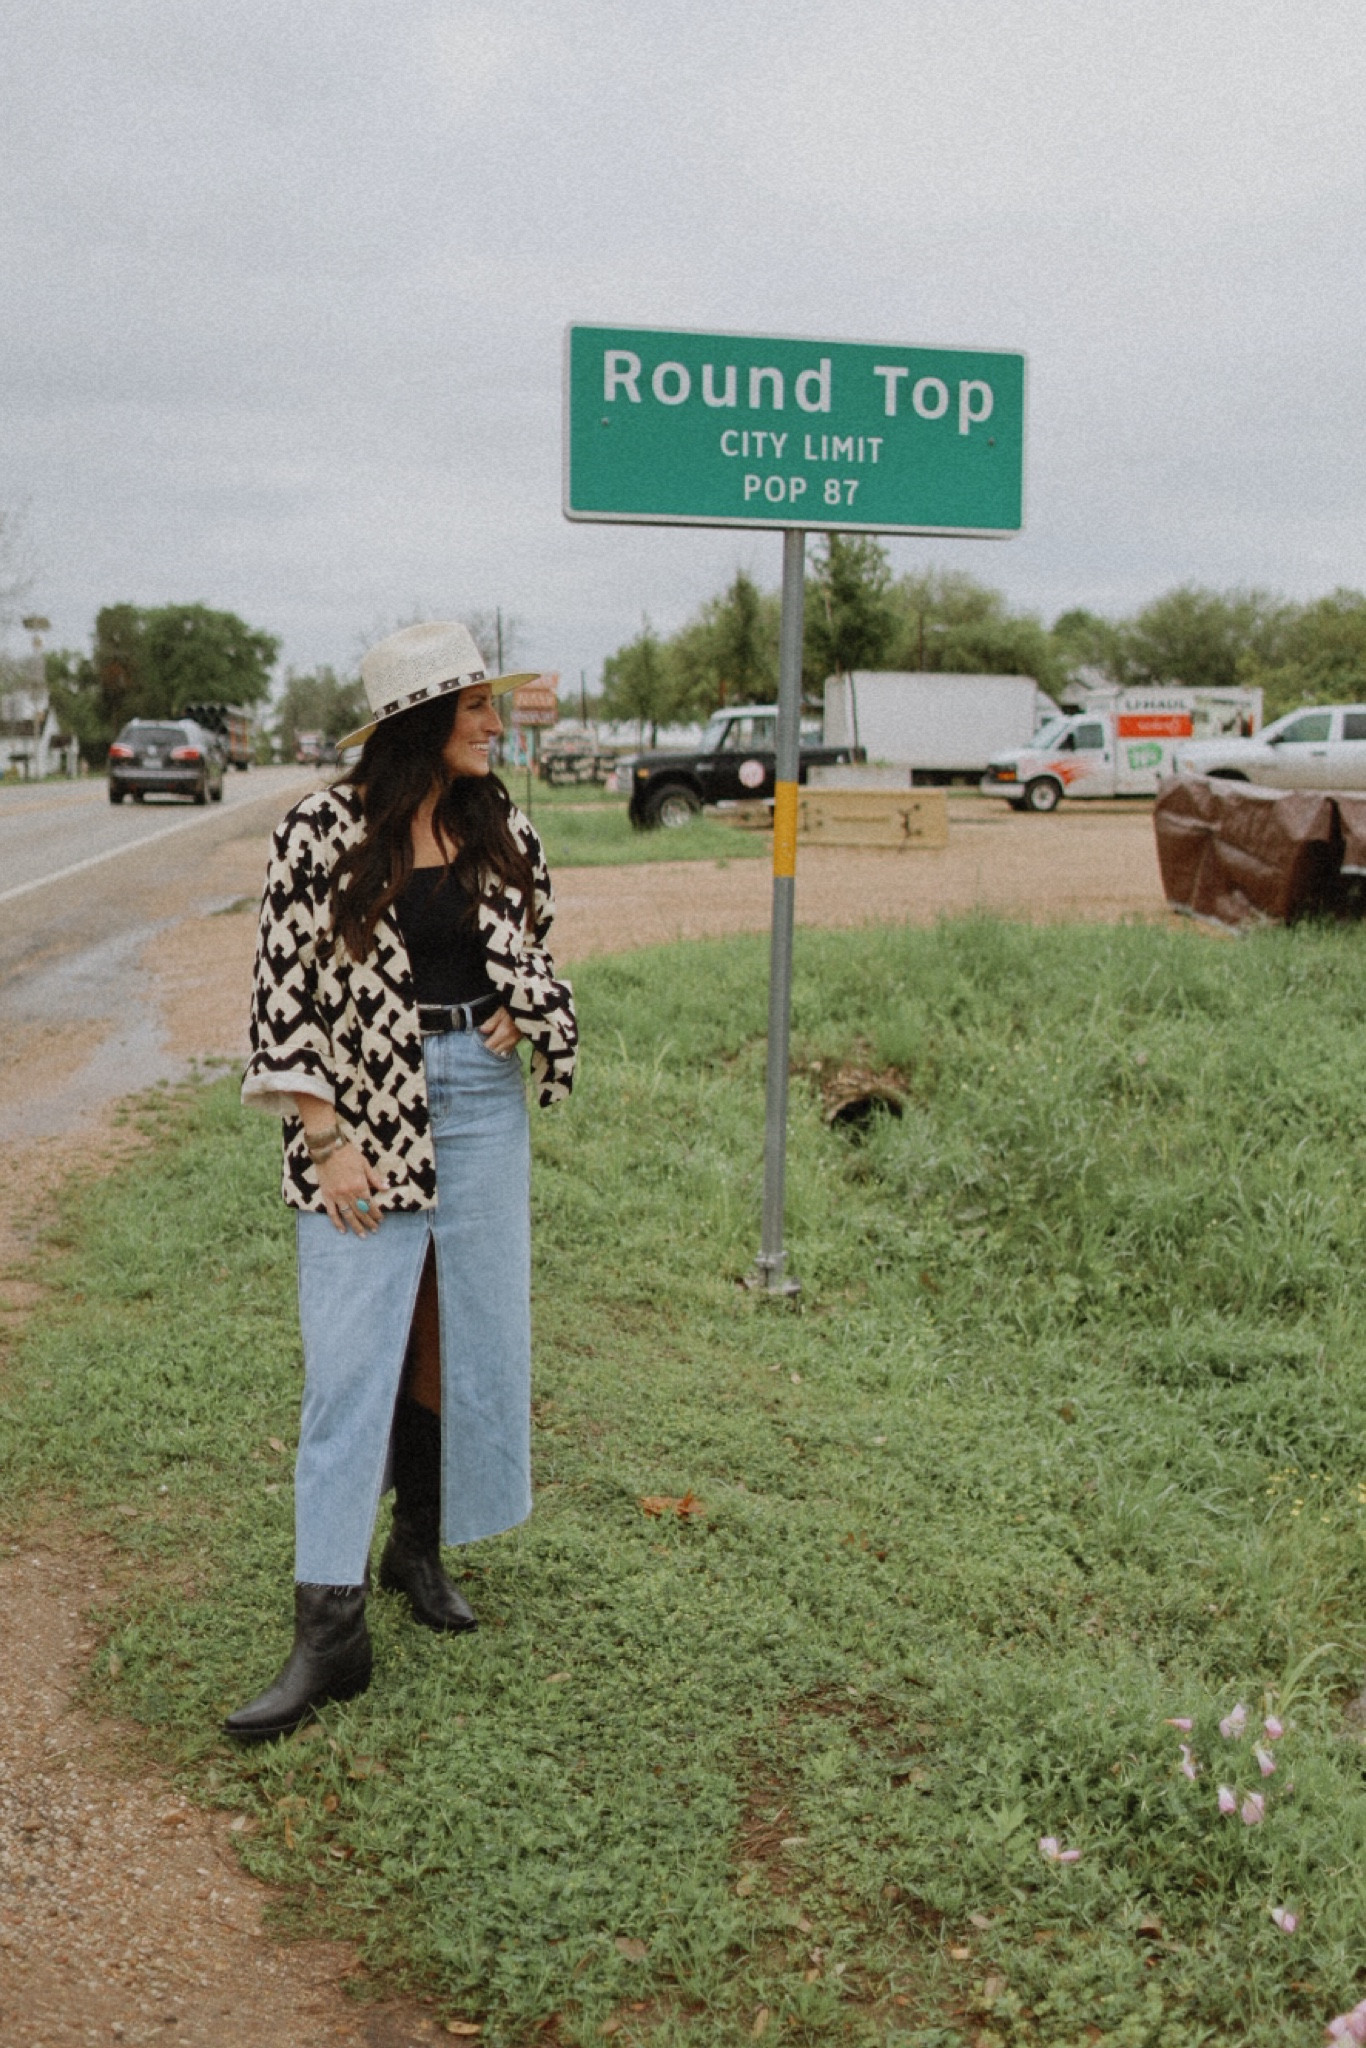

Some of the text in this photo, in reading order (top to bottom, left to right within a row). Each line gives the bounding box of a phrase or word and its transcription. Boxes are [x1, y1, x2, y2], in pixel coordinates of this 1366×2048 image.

[603, 349, 994, 436] Round Top
[720, 429, 884, 463] CITY LIMIT
[744, 474, 859, 506] POP 87
